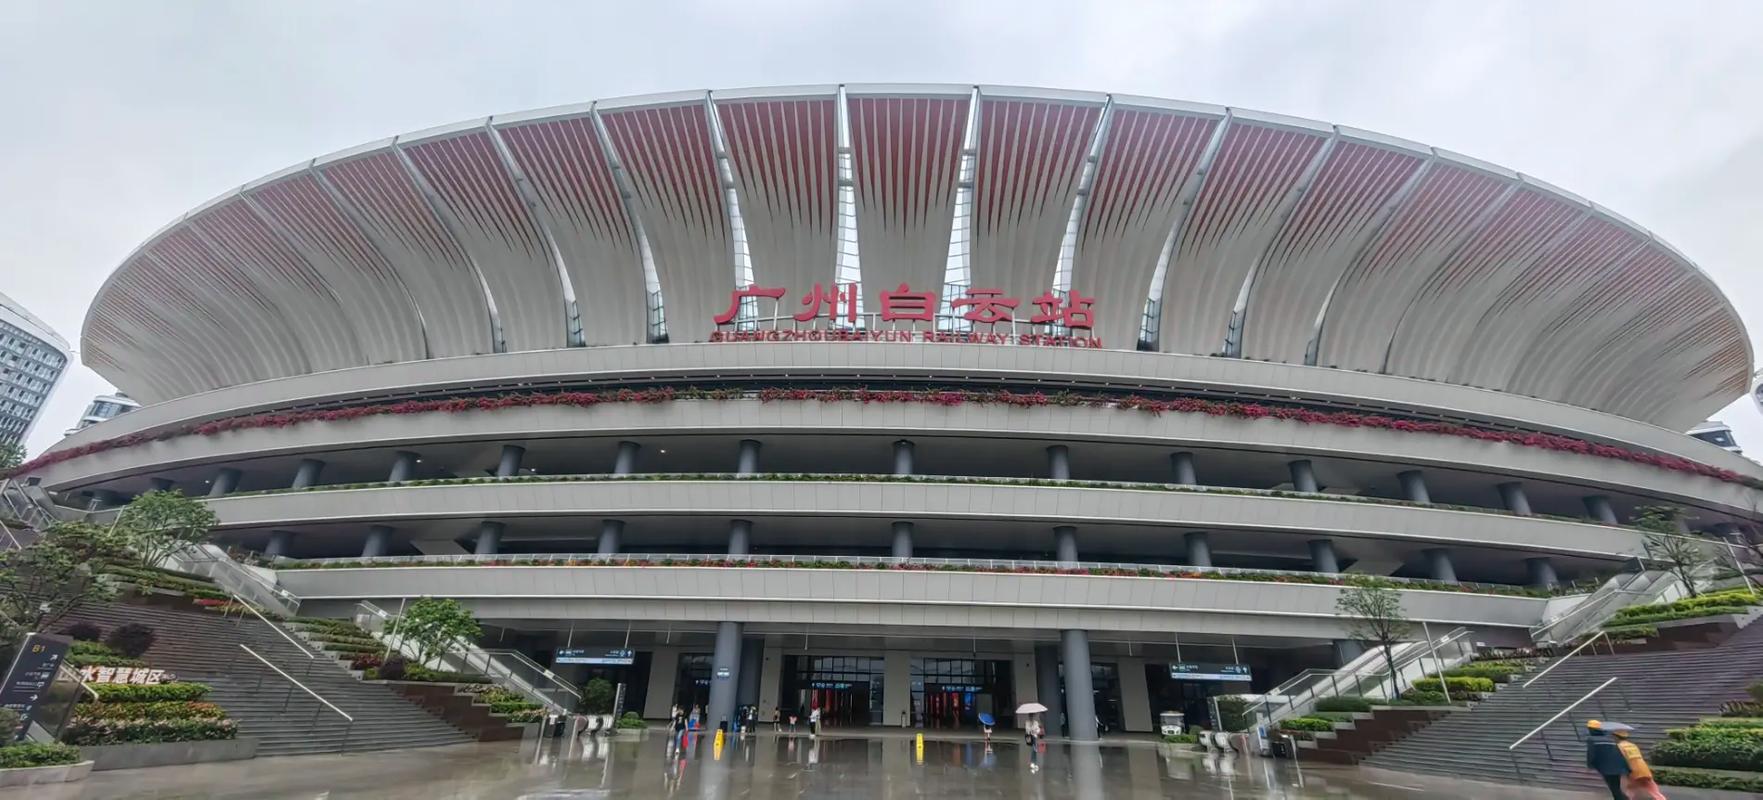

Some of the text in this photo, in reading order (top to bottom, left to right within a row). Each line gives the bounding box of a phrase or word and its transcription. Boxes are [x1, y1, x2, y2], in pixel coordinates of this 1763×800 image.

[713, 283, 1095, 328] 广州白云站
[922, 331, 1009, 345] RAILWAY
[1018, 333, 1103, 349] STATION
[32, 644, 46, 653] B1
